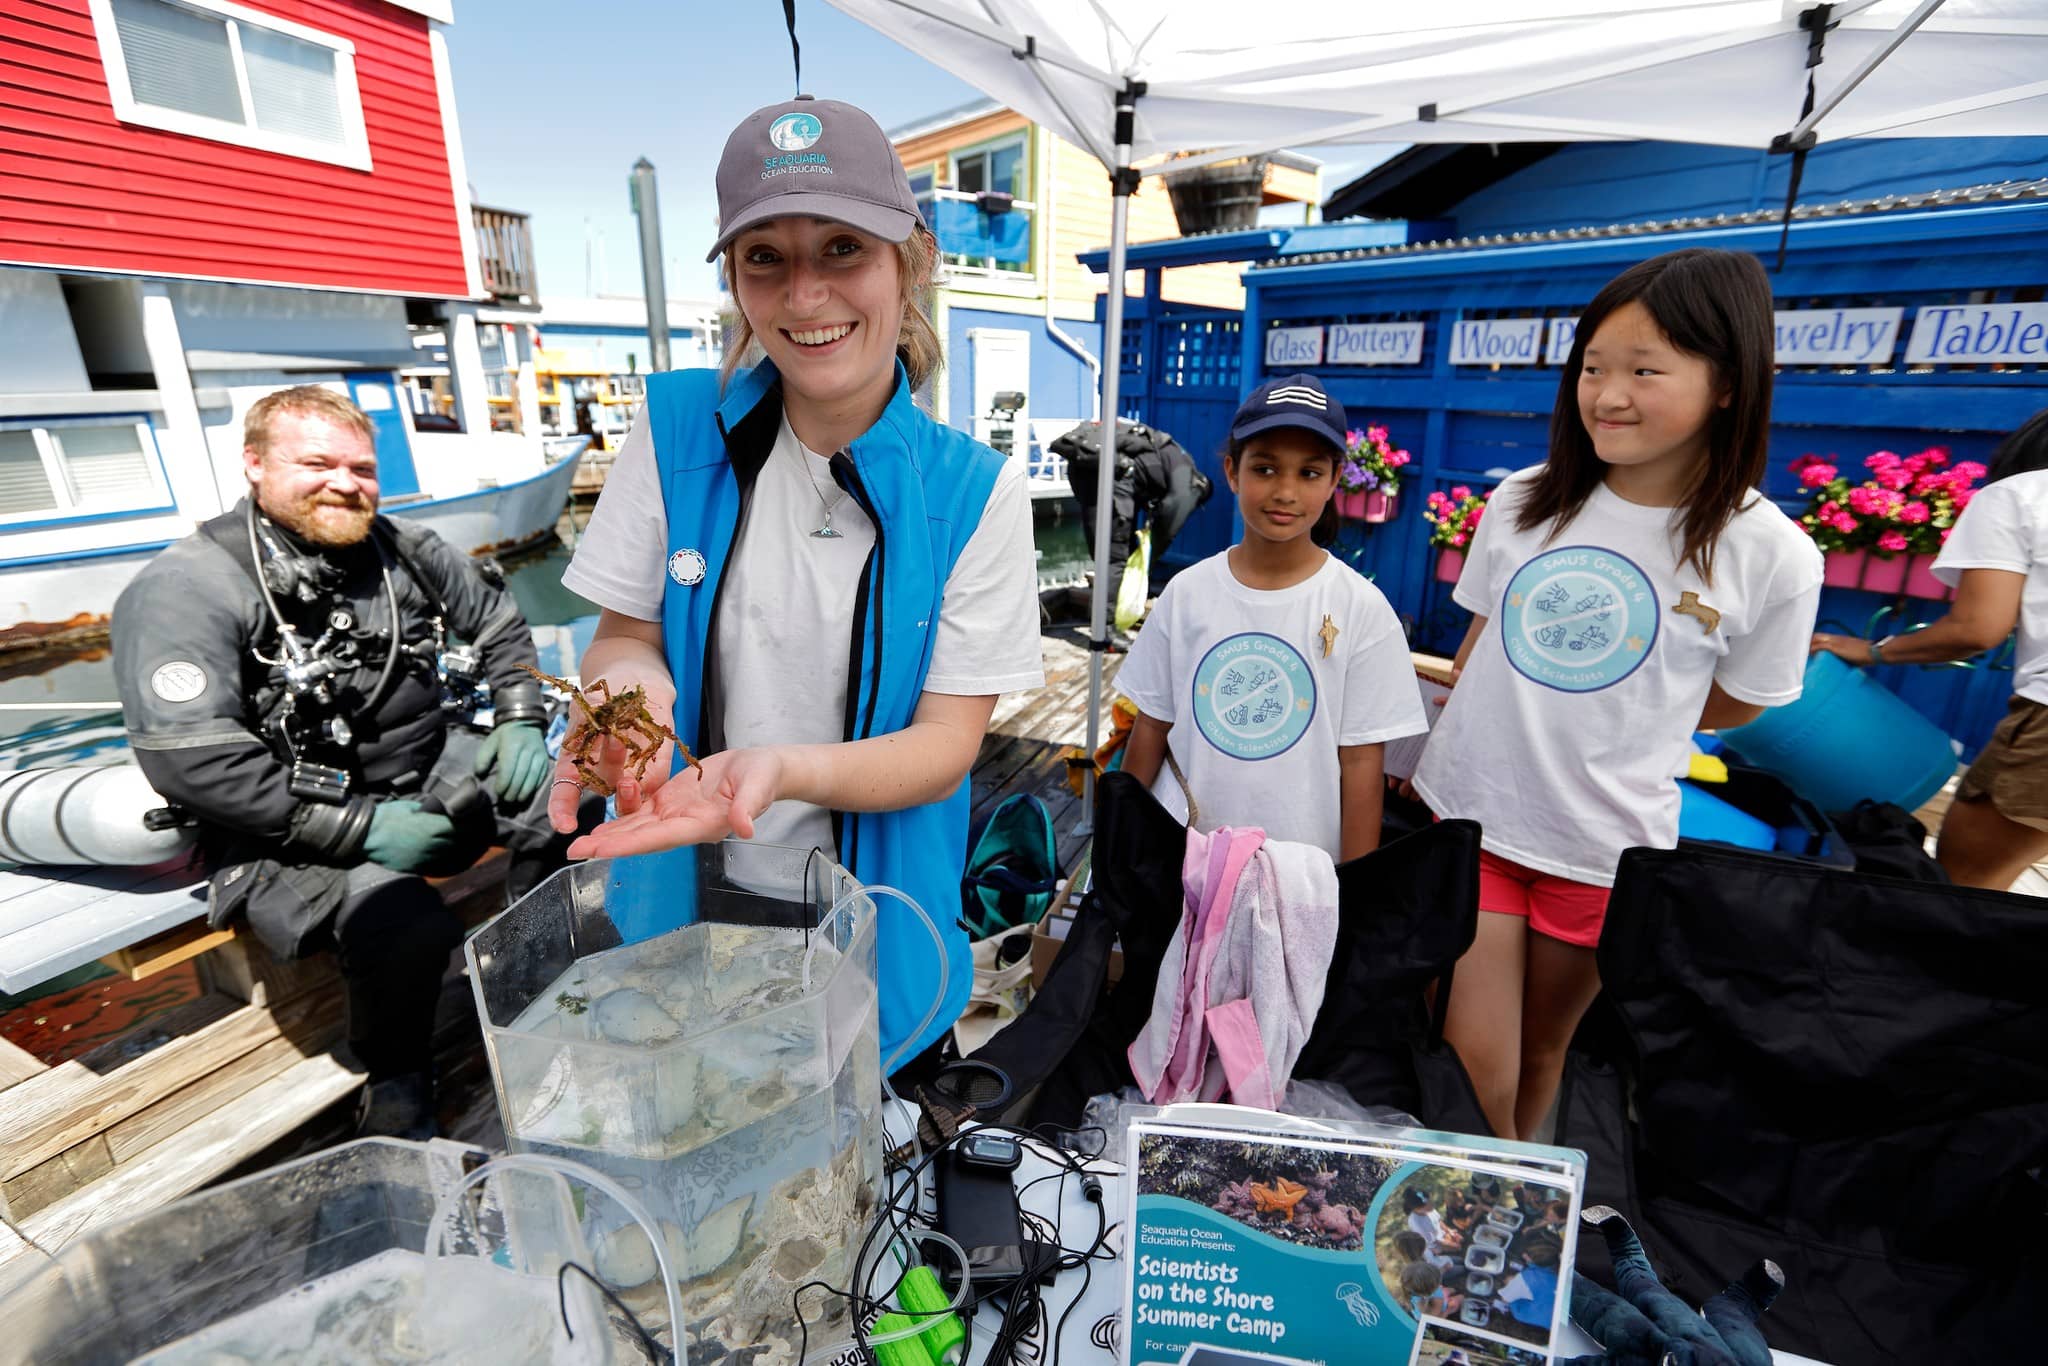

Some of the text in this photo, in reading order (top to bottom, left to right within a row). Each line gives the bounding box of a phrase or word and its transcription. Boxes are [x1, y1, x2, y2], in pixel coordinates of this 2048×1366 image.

[760, 165, 833, 180] OCEAN EDUCATION
[765, 153, 827, 169] SEAQUARIA
[1270, 331, 1317, 362] Glass
[1333, 325, 1416, 360] Pottery
[1459, 321, 1535, 360] Wood
[1775, 311, 1890, 361] welry
[1925, 307, 2048, 358] Table
[1543, 554, 1588, 571] SMUS
[1594, 556, 1637, 592] Grade
[1216, 640, 1250, 661] SMUS
[1254, 640, 1290, 663] Grade
[1543, 665, 1604, 682] Scientists
[1141, 1223, 1223, 1241] Seaquaria Ocean
[1141, 1234, 1236, 1252] Education Presents:
[1138, 1254, 1239, 1284] Scientists
[1138, 1282, 1275, 1311] on the Shore
[1137, 1304, 1286, 1343] Summer Camp
[1145, 1339, 1189, 1353] For cam
